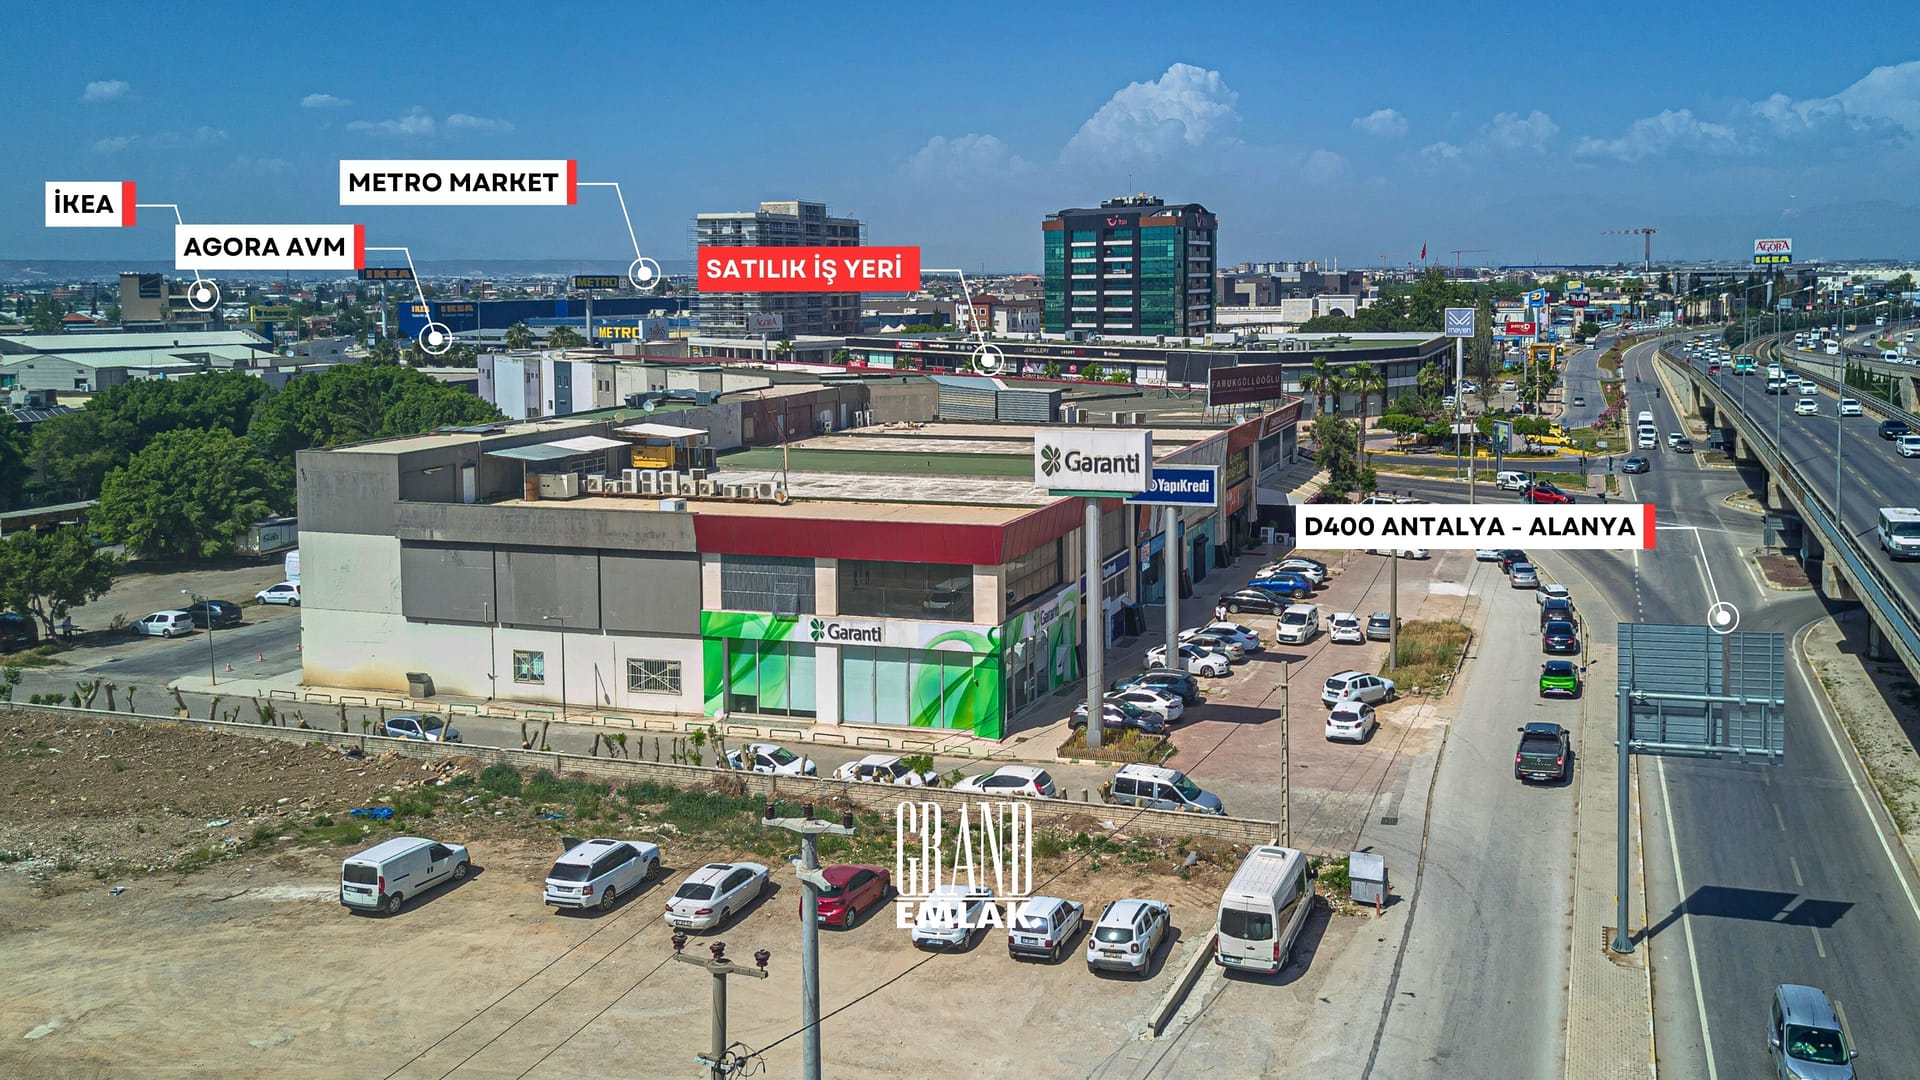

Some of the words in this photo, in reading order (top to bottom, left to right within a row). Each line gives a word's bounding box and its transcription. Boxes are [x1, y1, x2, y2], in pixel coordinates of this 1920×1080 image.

[1756, 240, 1790, 253] AGORA
[1755, 255, 1790, 264] IKEA
[366, 269, 411, 279] IKEA
[576, 277, 618, 288] METRO
[441, 304, 475, 313] IKEA
[599, 326, 640, 339] METRO
[1064, 450, 1140, 475] Garanti
[827, 622, 882, 643] Garanti
